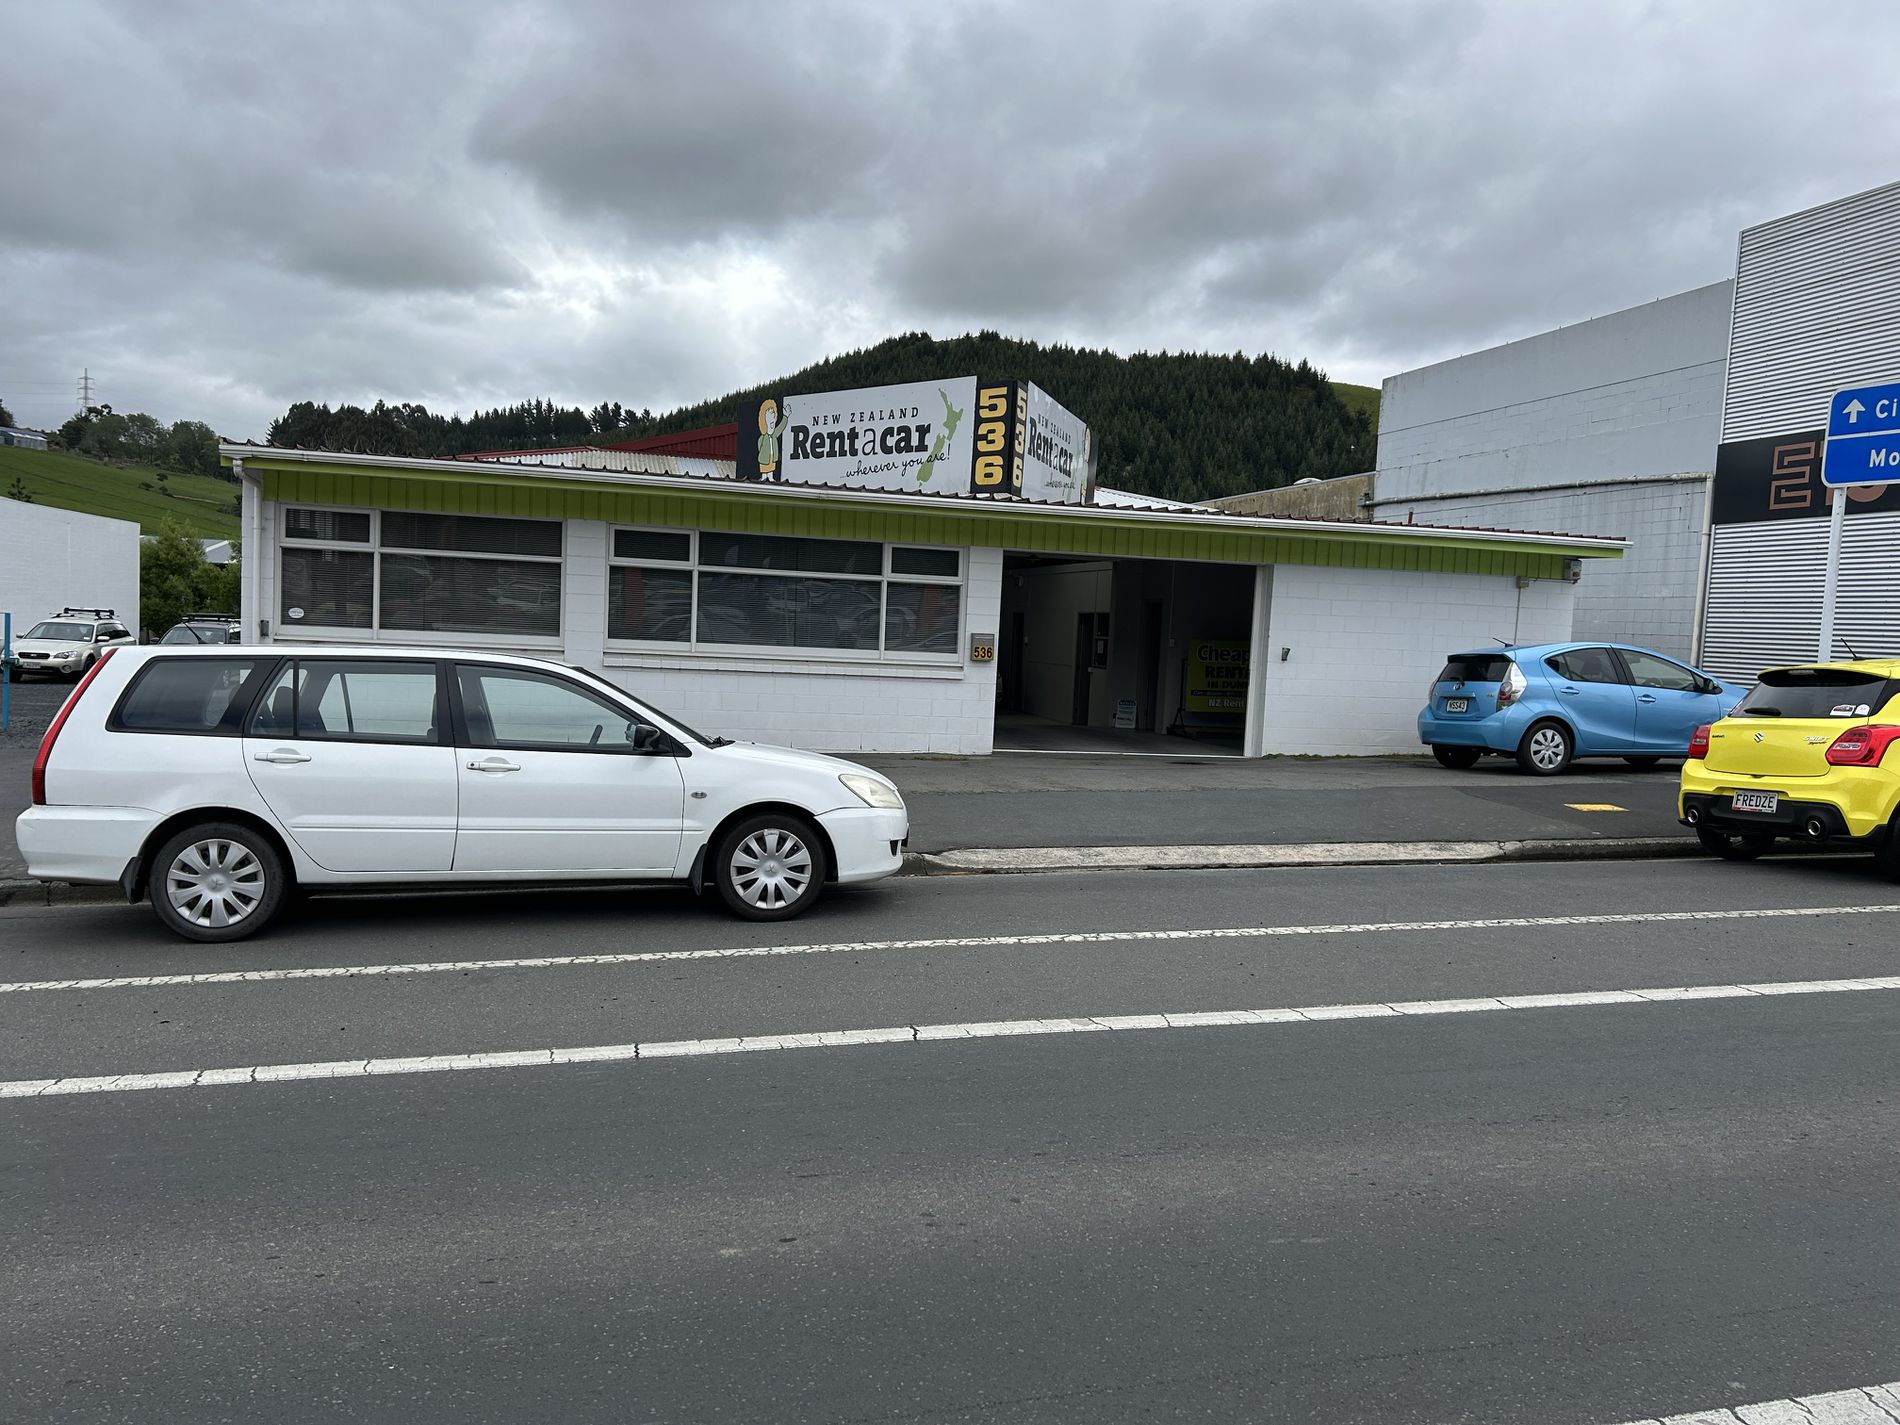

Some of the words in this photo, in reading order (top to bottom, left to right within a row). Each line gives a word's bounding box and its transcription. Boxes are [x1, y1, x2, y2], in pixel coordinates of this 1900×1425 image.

[812, 414, 841, 427] NEW
[850, 407, 919, 423] ZEALAND
[1875, 398, 1898, 418] Ci
[901, 457, 924, 477] you
[926, 442, 951, 463] are!
[1869, 448, 1900, 468] Mo
[974, 646, 993, 659] 536
[1207, 681, 1219, 689] IN
[1735, 793, 1775, 809] FREDZE
